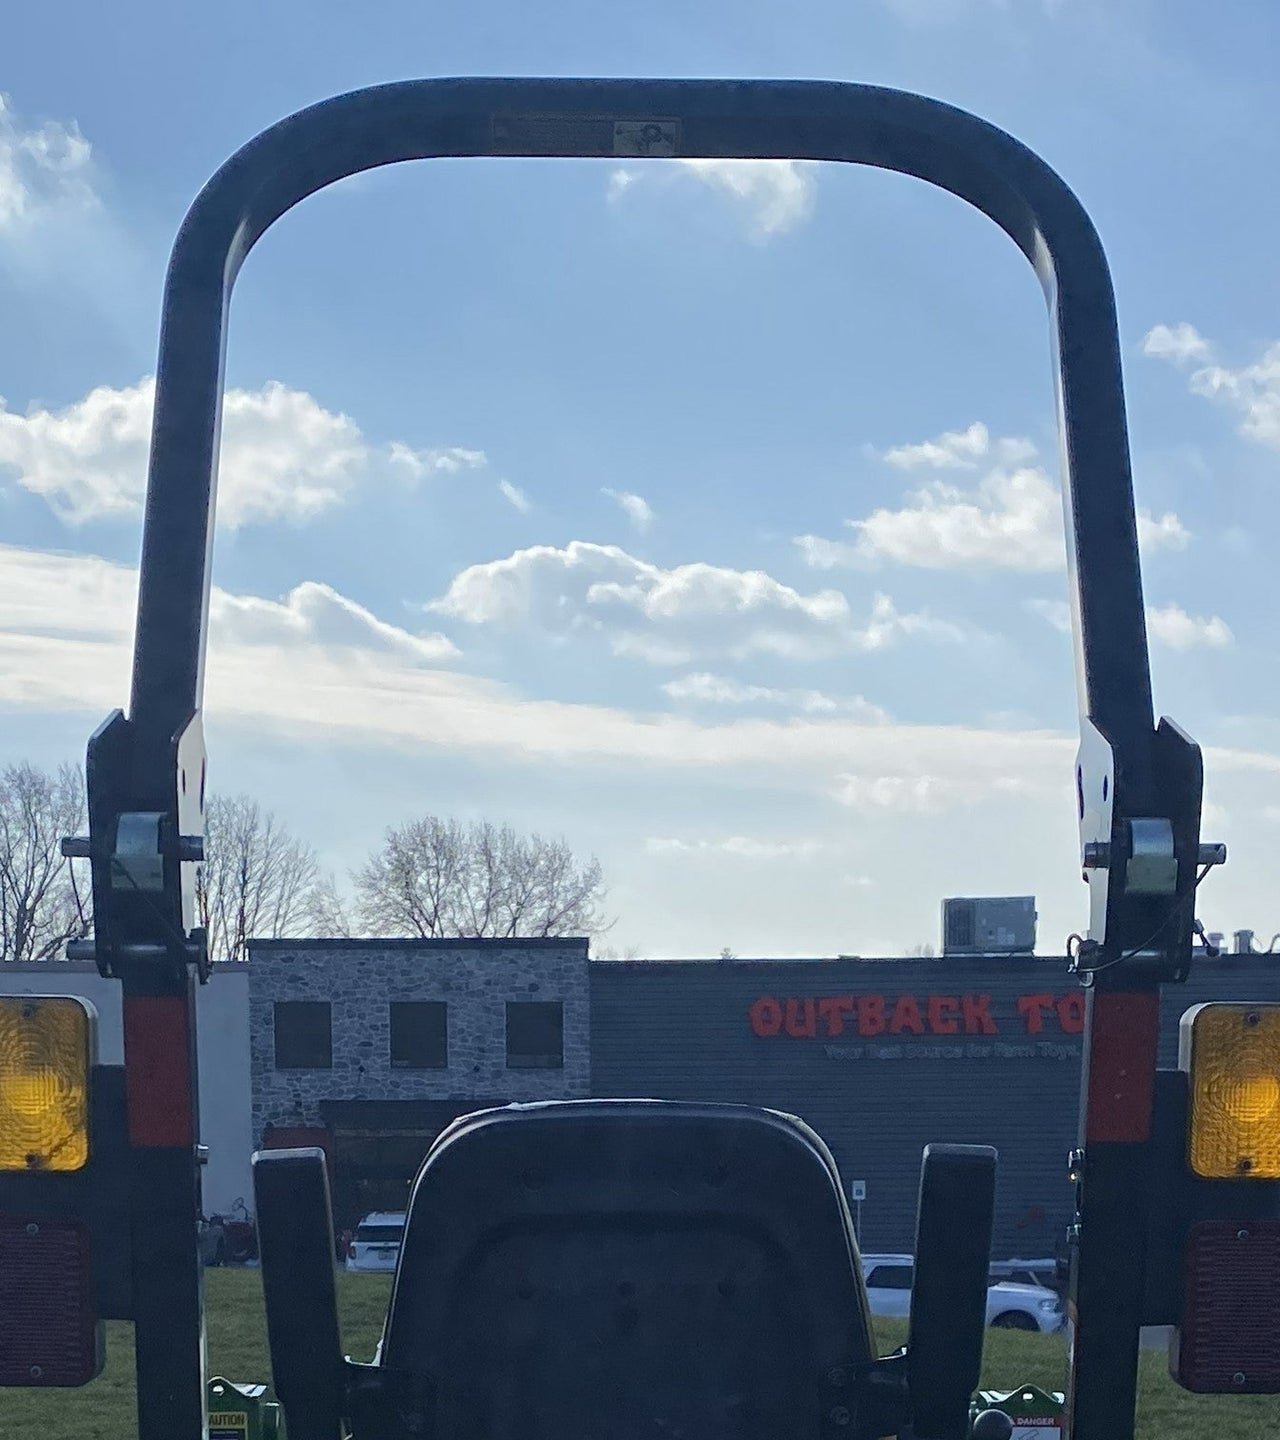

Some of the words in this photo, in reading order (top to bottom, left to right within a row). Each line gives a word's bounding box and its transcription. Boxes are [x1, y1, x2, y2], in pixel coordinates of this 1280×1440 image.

[749, 995, 997, 1038] OUTBACK
[1019, 994, 1085, 1034] TO
[1016, 1417, 1055, 1425] DANGER
